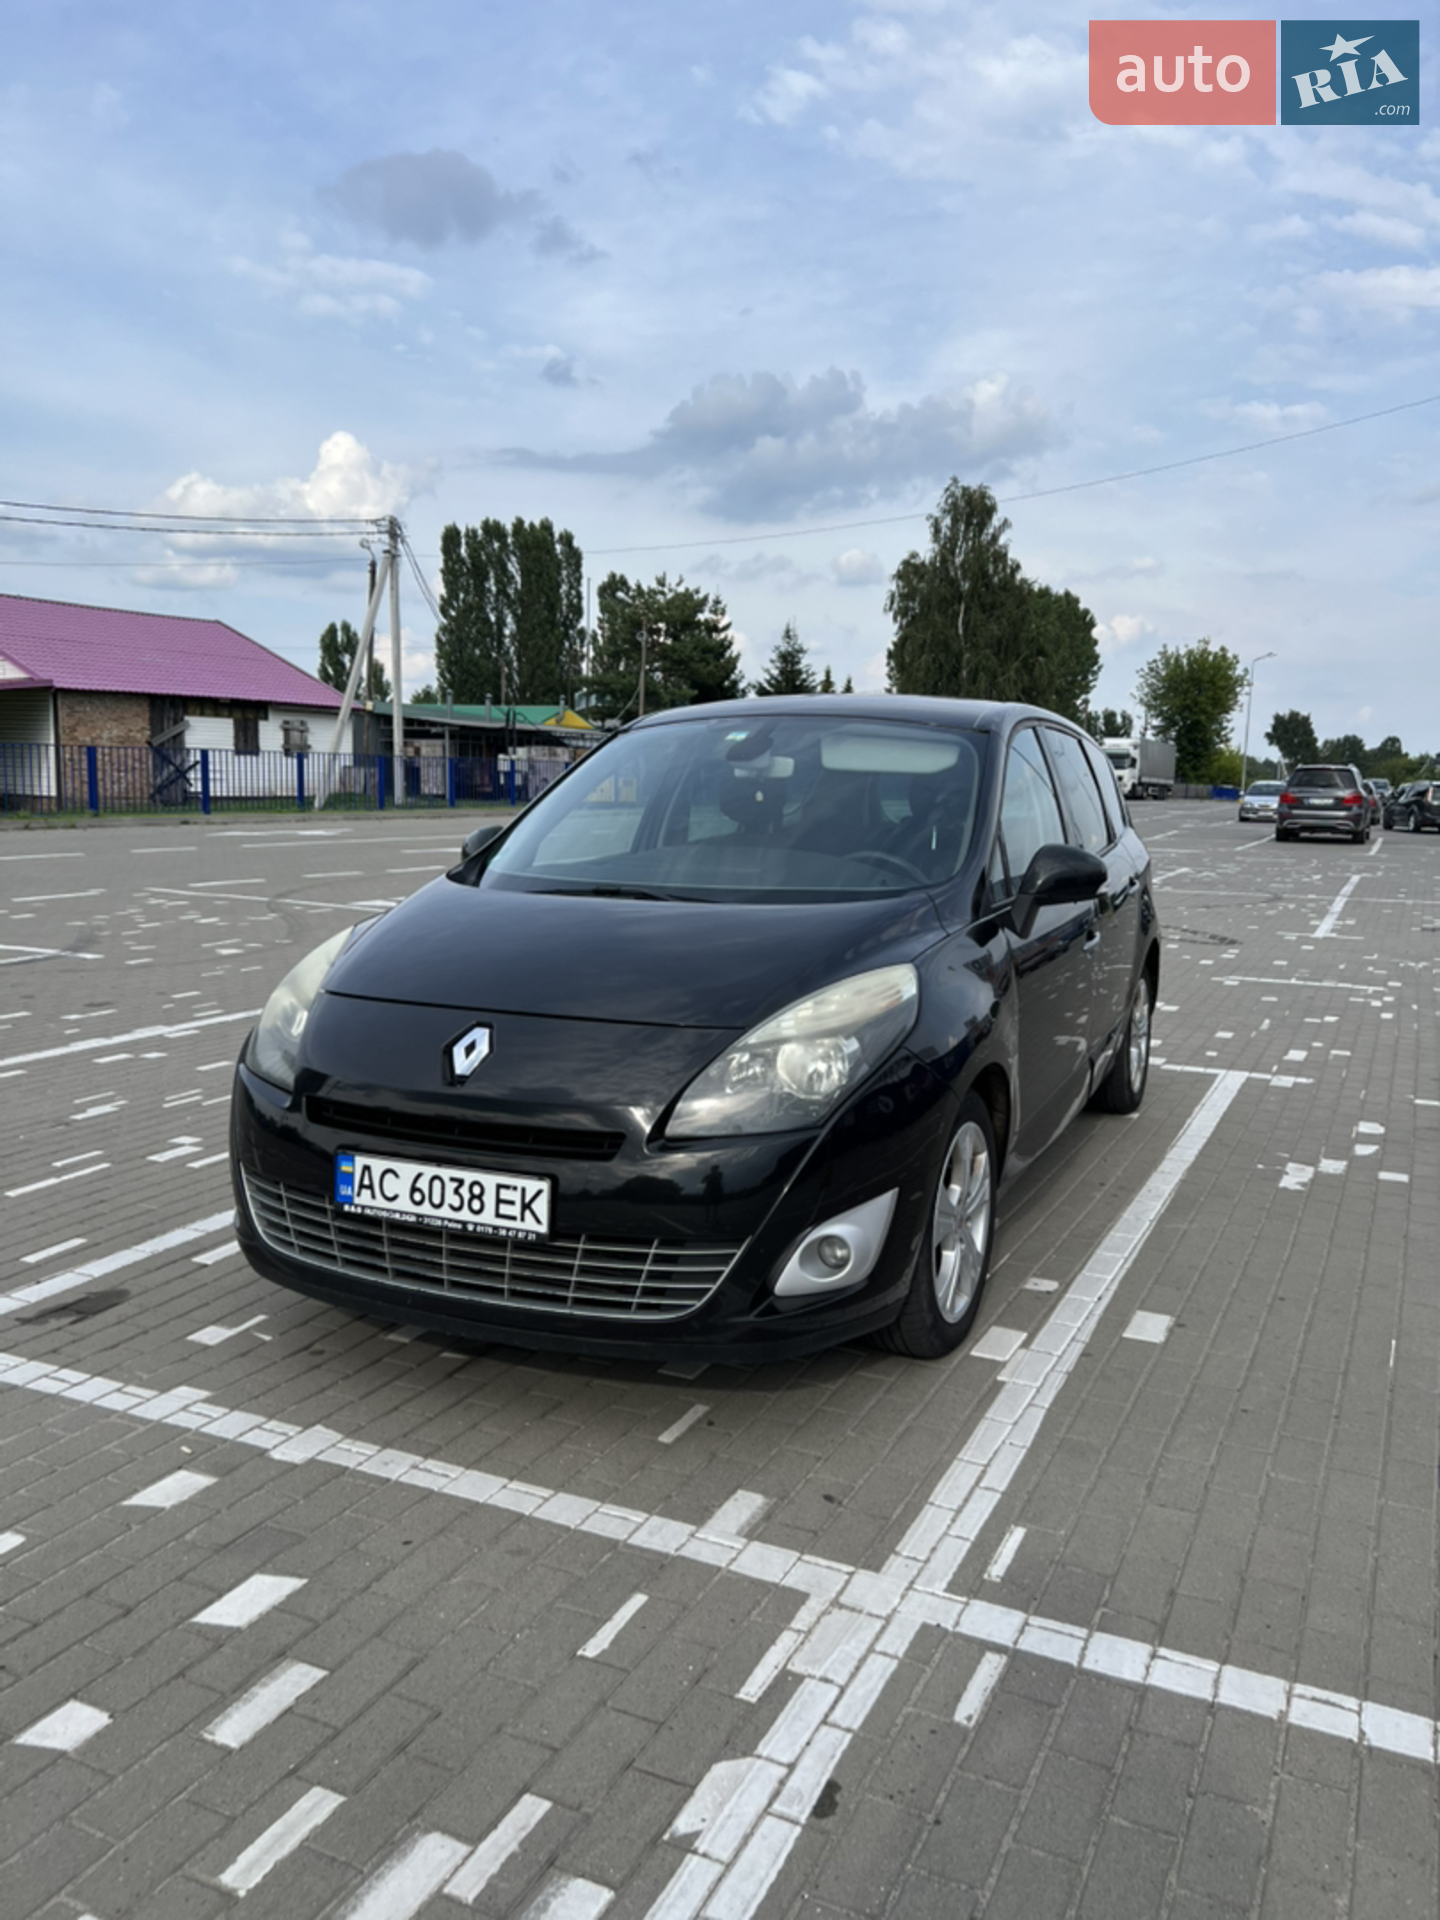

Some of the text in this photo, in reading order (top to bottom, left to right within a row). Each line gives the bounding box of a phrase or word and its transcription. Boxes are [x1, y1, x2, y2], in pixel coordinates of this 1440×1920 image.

[340, 1184, 353, 1196] UA
[356, 1164, 545, 1226] AC 6038 EK
